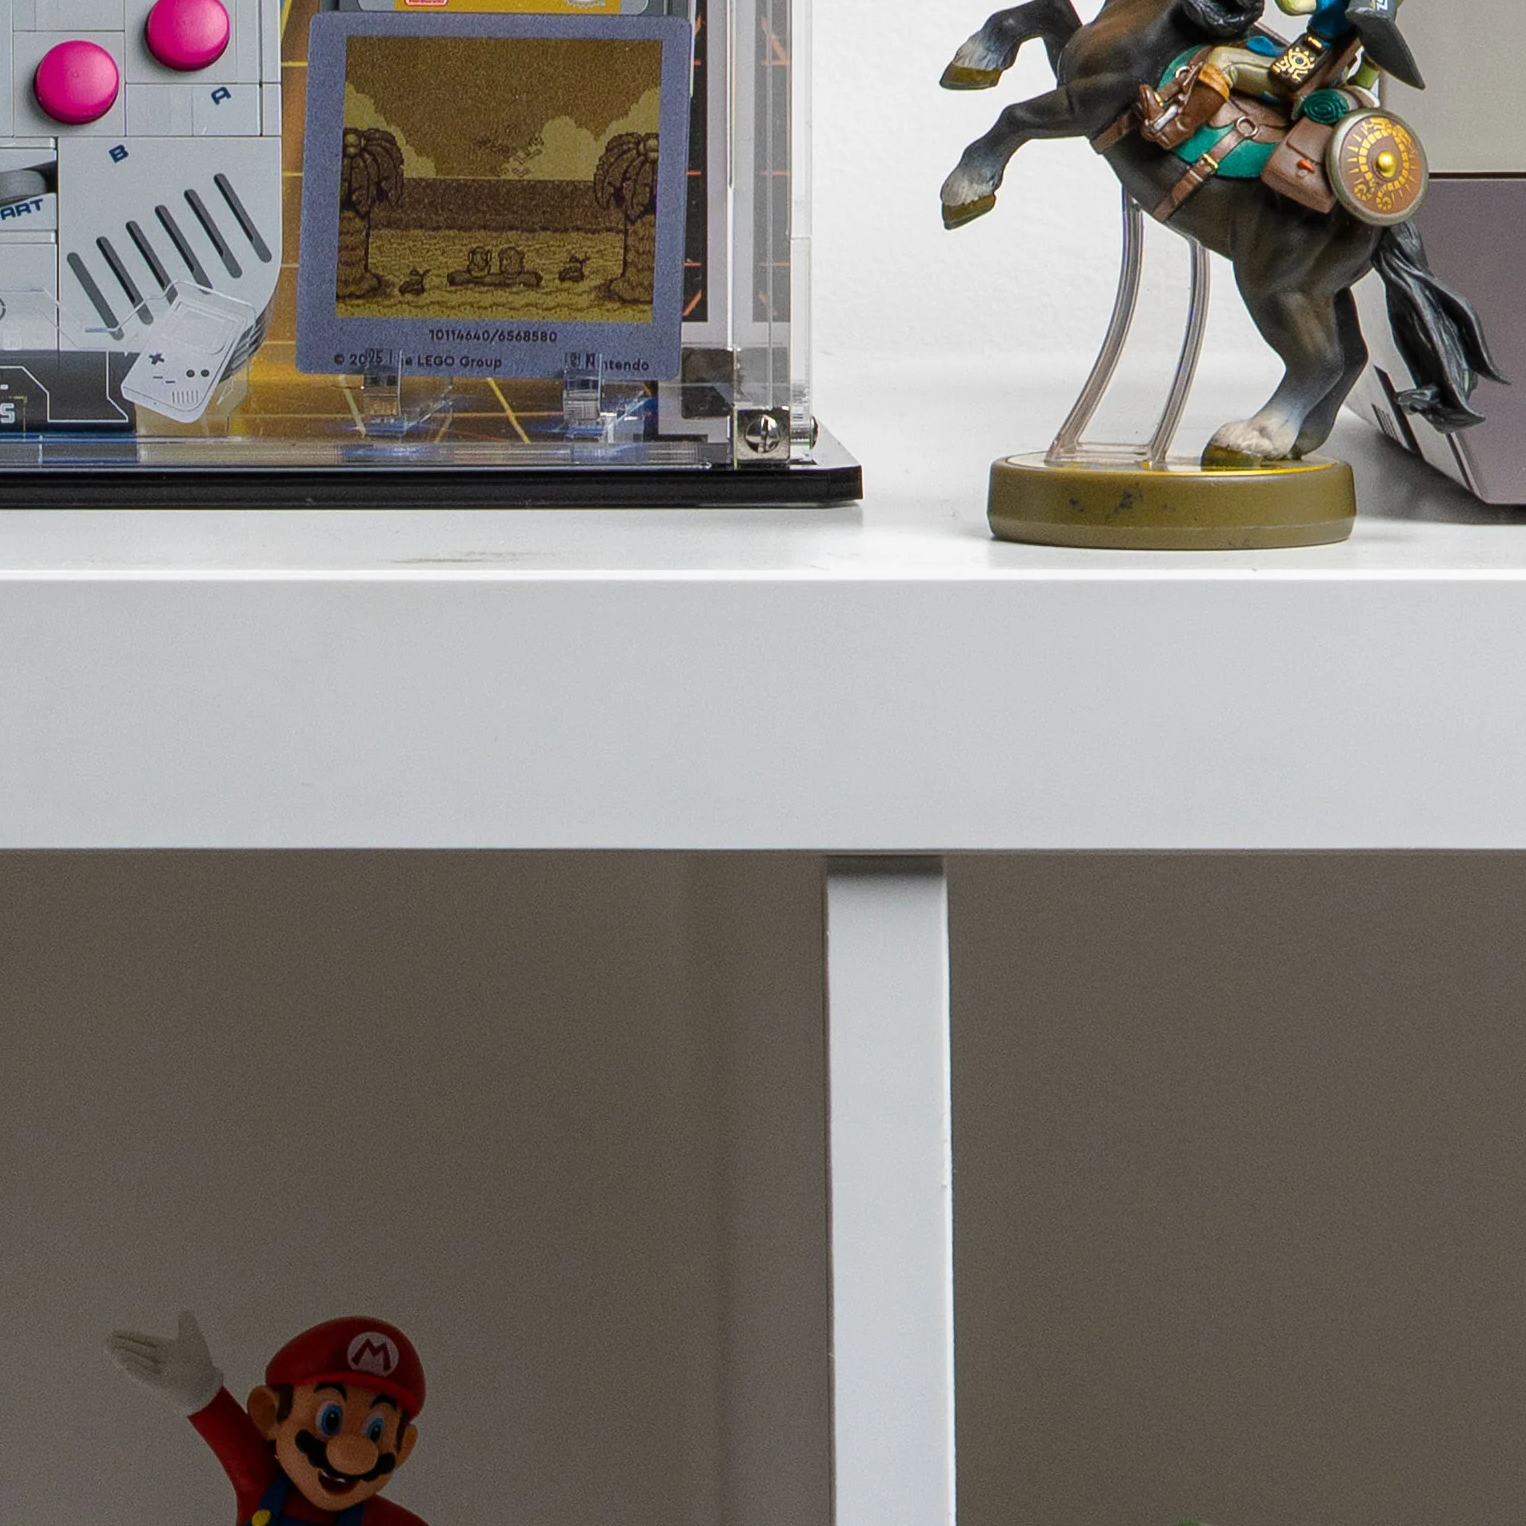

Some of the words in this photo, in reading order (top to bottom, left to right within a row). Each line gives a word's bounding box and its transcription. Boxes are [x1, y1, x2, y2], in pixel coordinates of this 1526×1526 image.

[210, 86, 232, 106] A
[108, 145, 130, 164] B
[429, 329, 558, 343] 10114640/6568580
[417, 356, 455, 367] LEGO
[460, 356, 502, 369] Group
[351, 1337, 392, 1372] M
